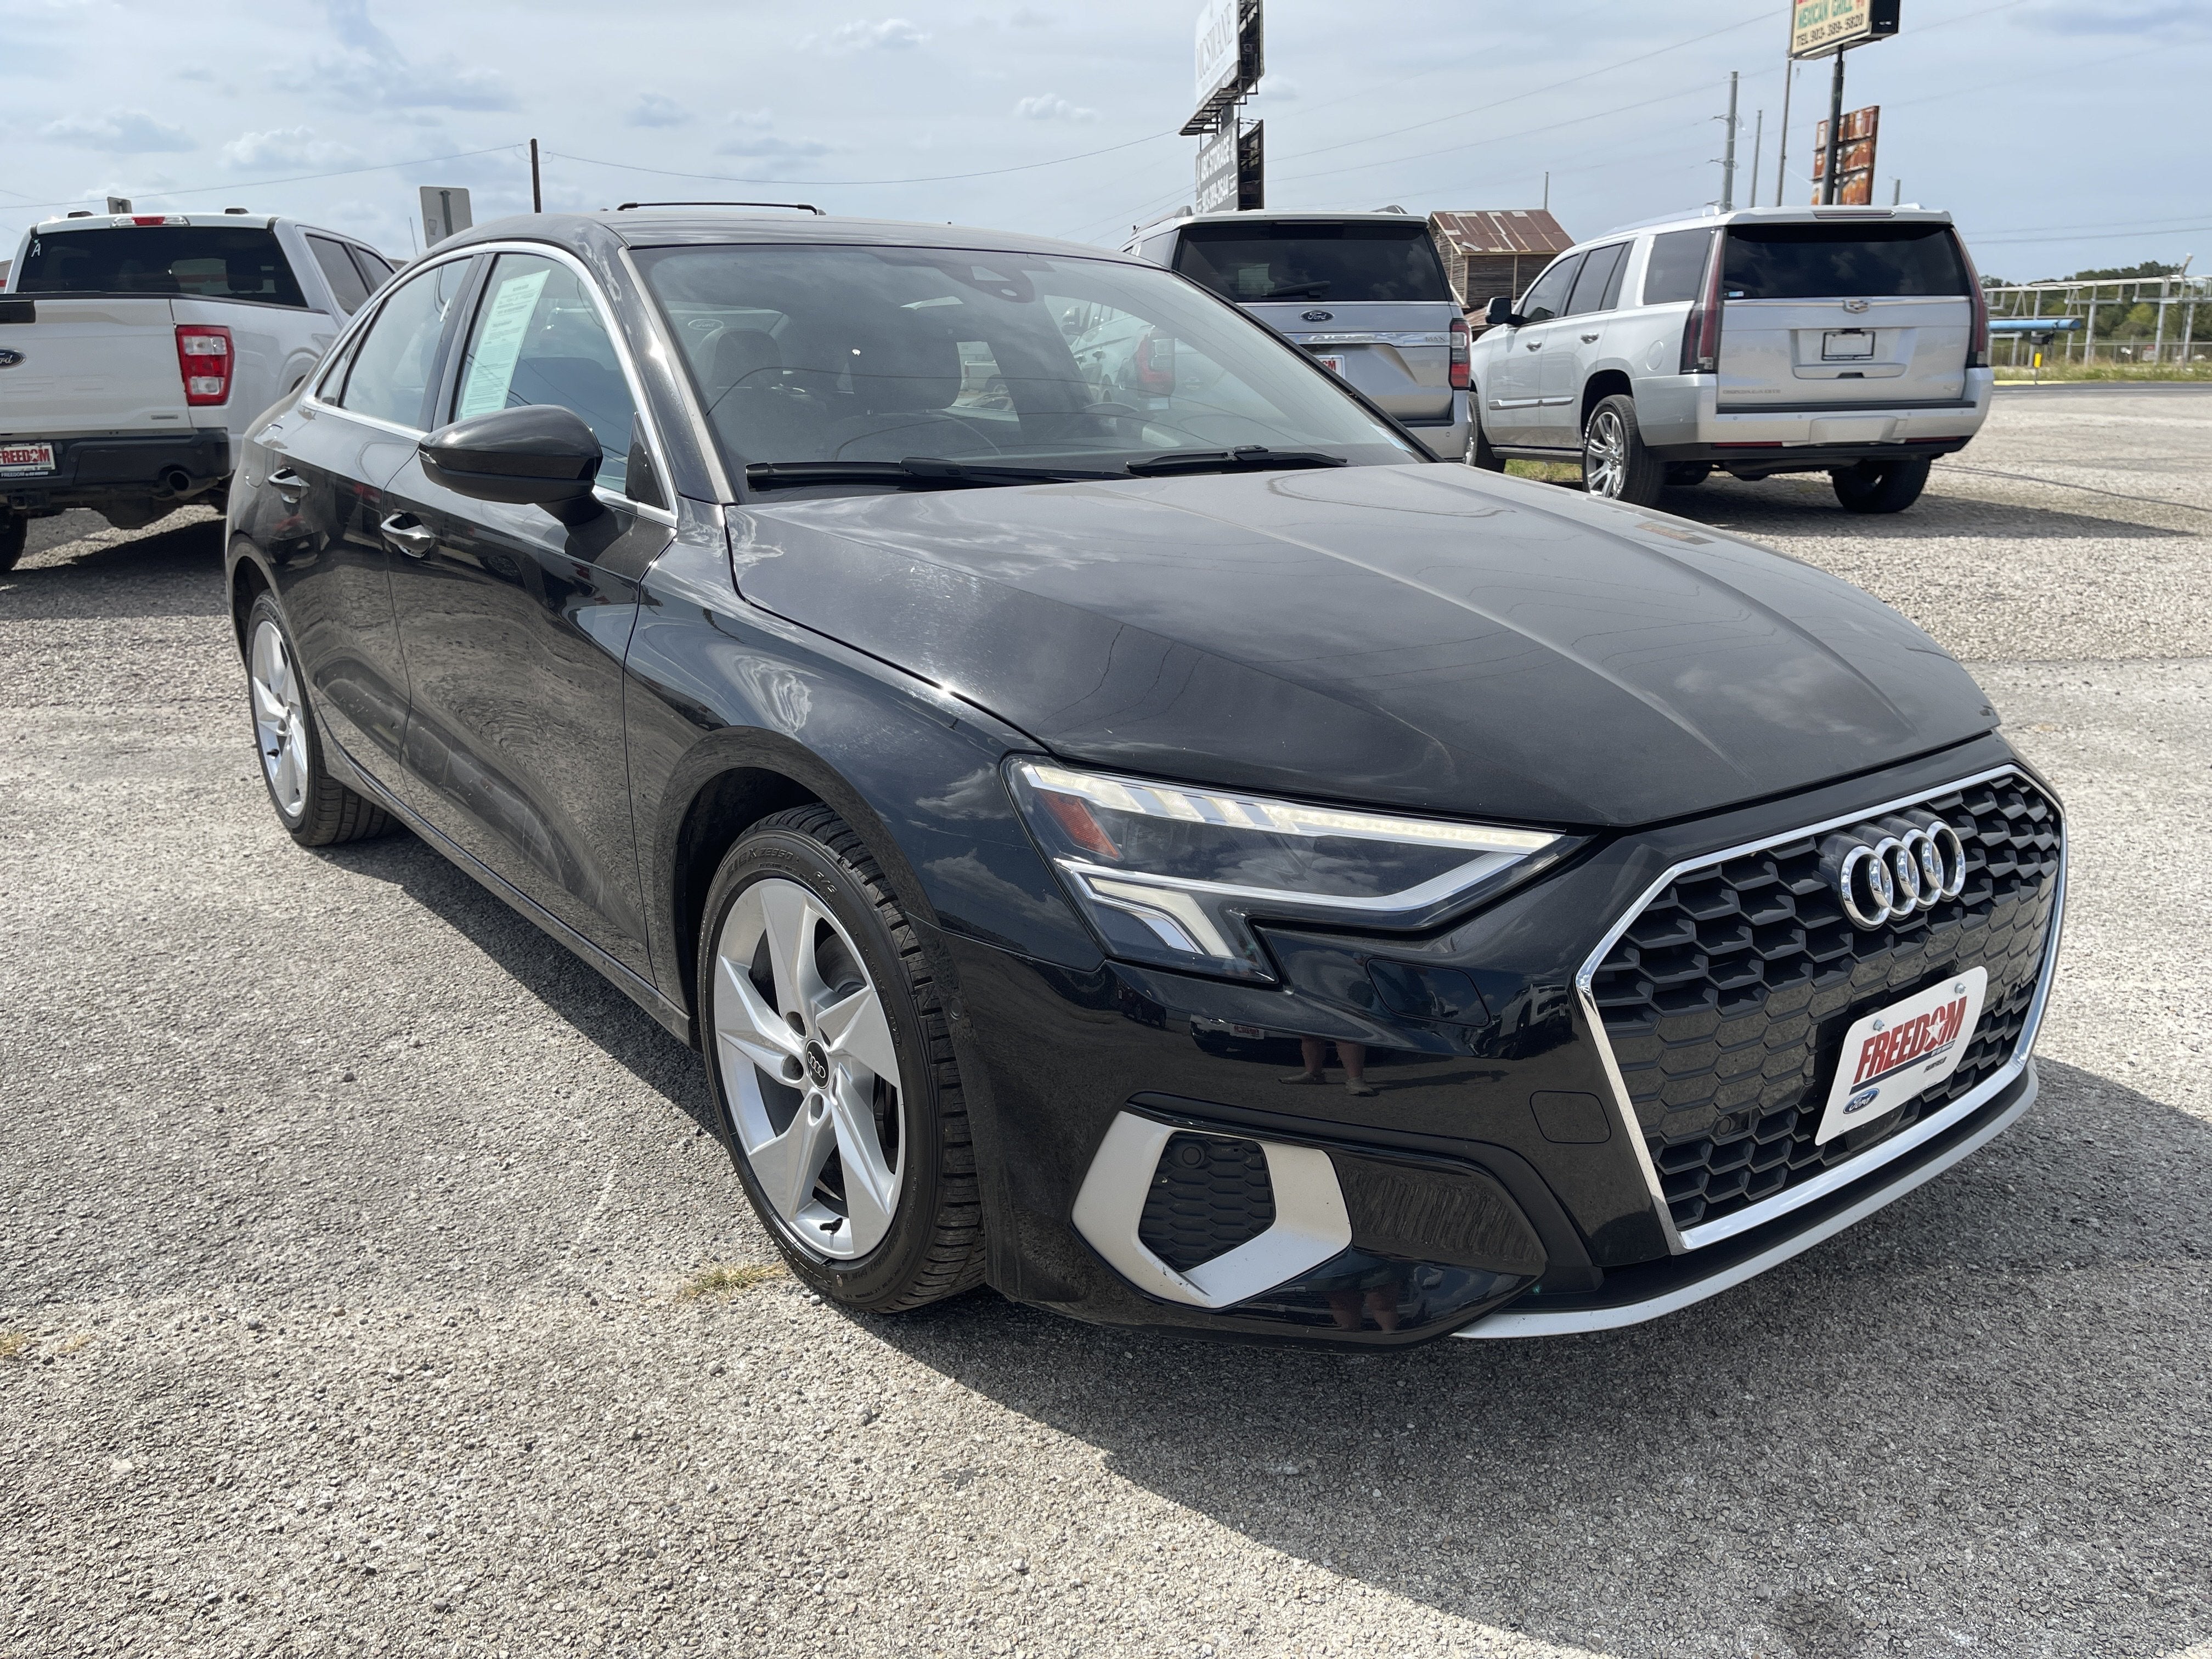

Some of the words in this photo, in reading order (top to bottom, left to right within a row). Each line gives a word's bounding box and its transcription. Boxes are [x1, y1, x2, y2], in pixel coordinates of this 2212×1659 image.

[31, 242, 41, 257] A
[1853, 996, 1967, 1085] FREEDOM
[1849, 1093, 1873, 1111] Ford
